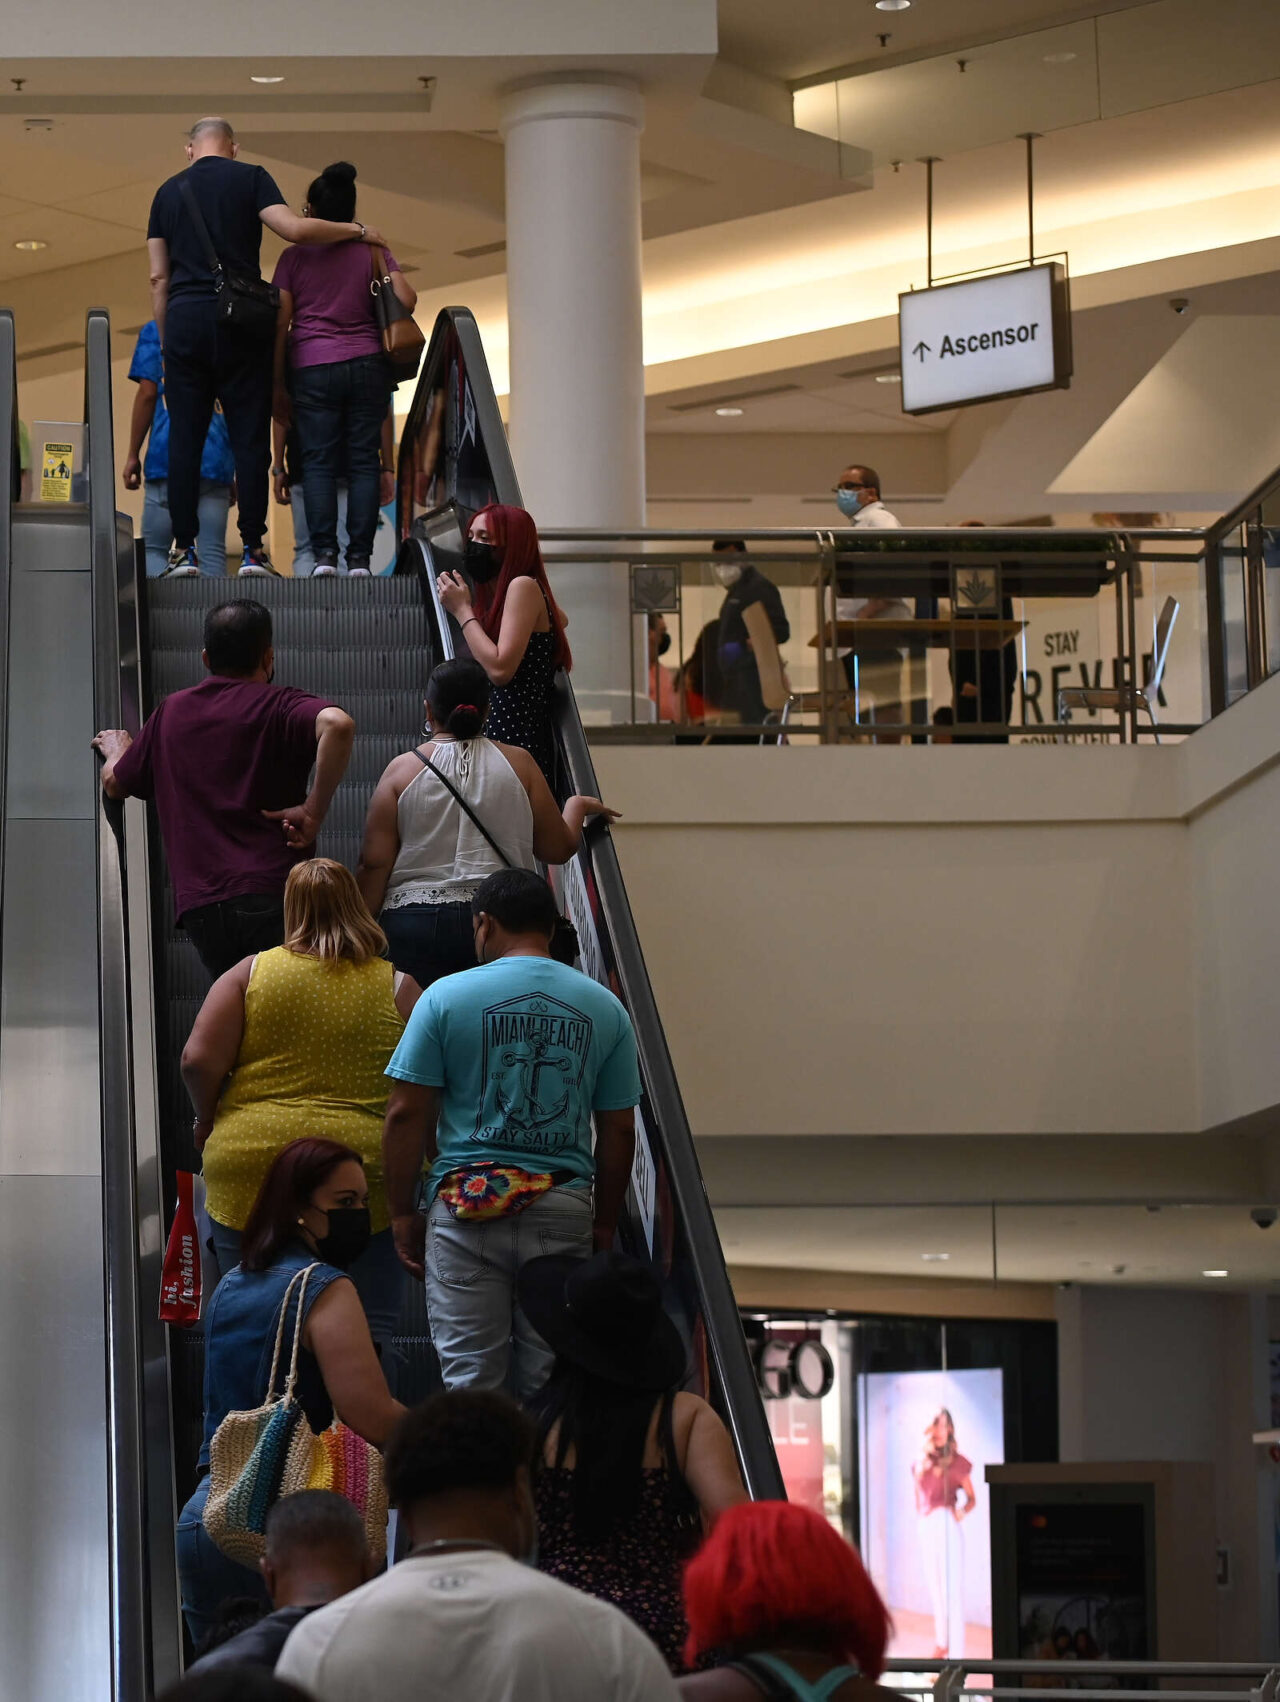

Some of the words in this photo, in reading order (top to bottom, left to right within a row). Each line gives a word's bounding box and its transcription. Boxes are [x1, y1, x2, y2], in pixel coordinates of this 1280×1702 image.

[939, 322, 1039, 359] Ascensor
[1044, 630, 1080, 657] STAY
[491, 1015, 536, 1048] MIAMI
[540, 1018, 585, 1056] BEACH
[482, 1126, 519, 1143] STAY
[523, 1132, 571, 1147] SALTY
[180, 1235, 197, 1309] fashion
[164, 1282, 178, 1304] hi,
